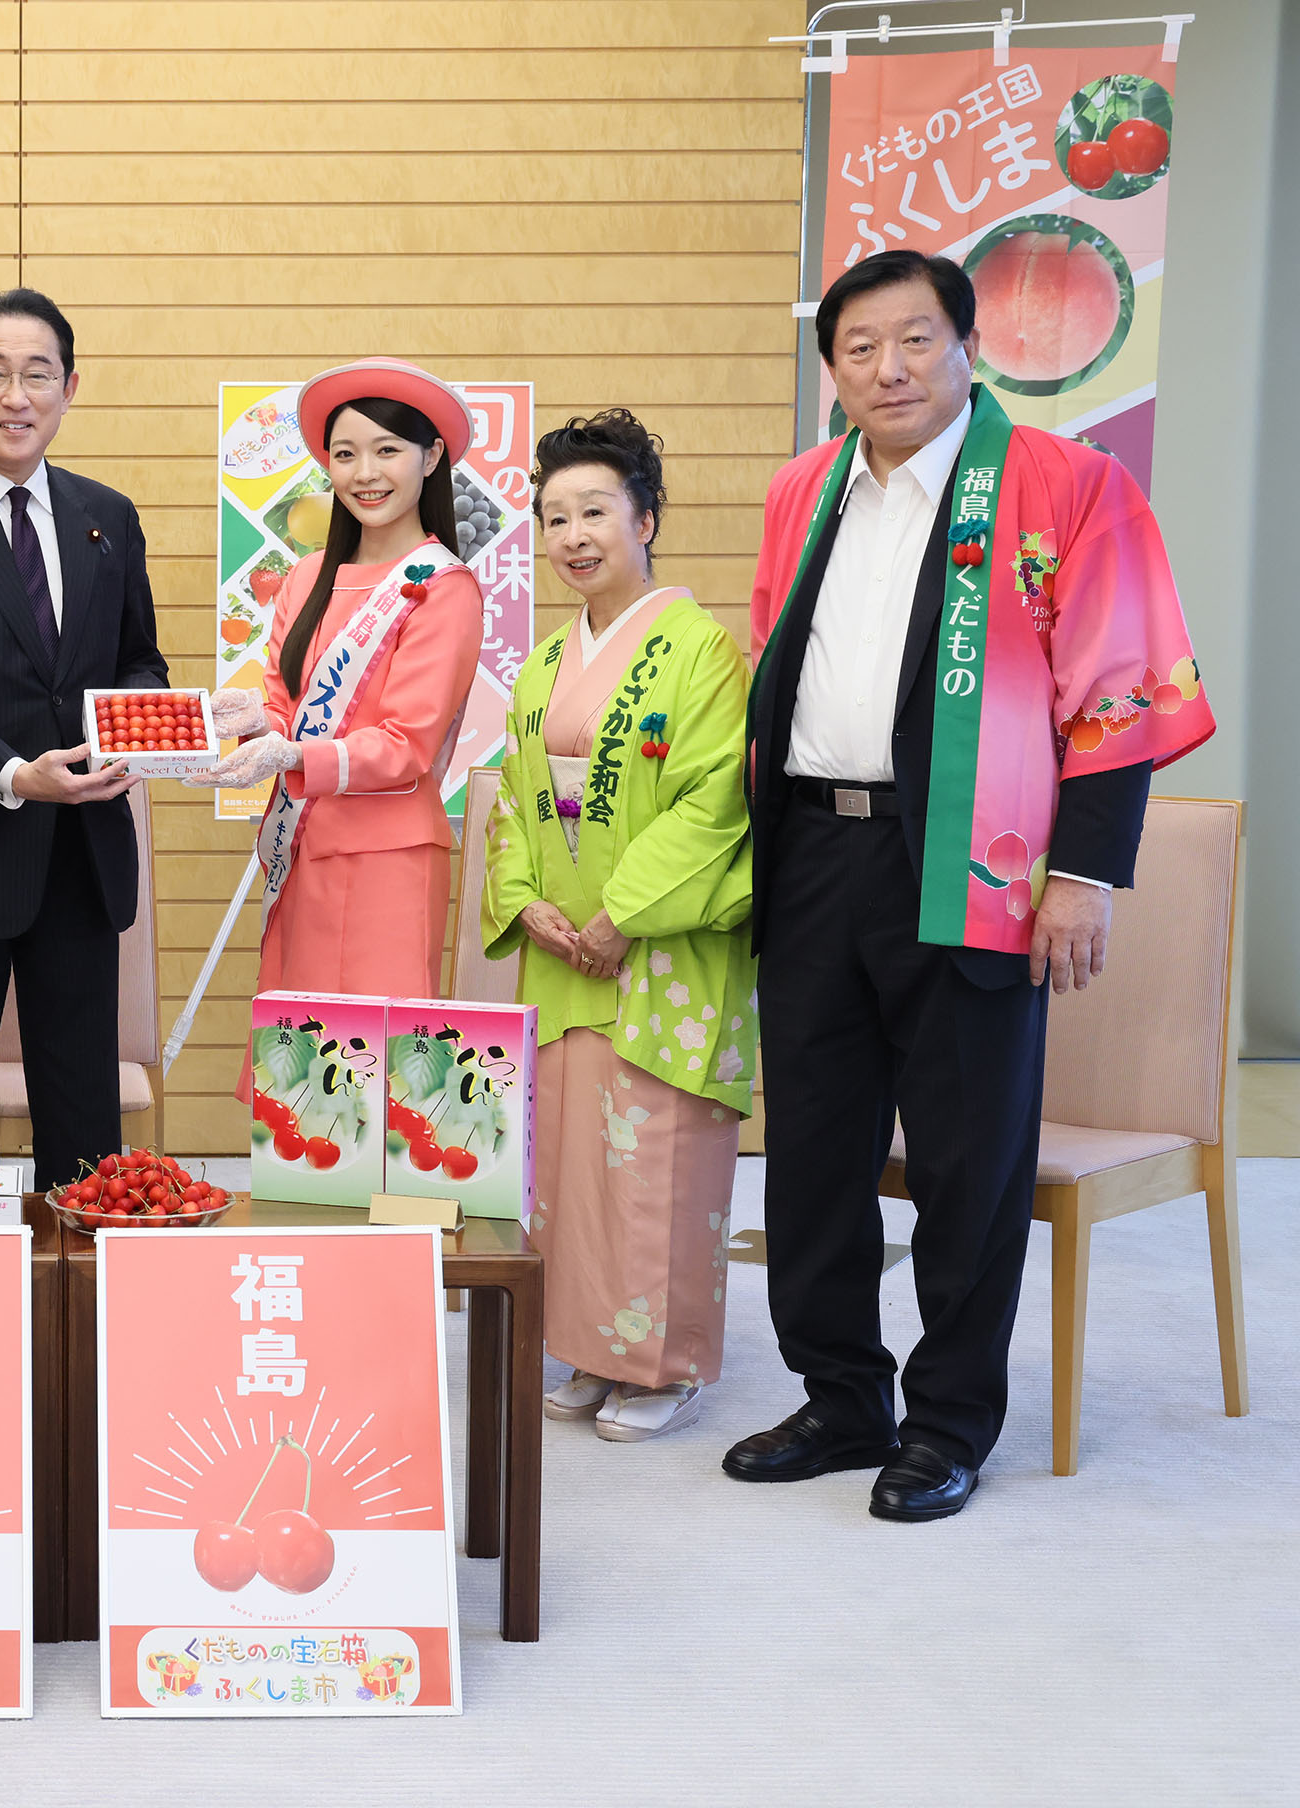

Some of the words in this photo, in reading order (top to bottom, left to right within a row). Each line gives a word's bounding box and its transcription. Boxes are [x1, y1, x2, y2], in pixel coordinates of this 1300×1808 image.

[841, 63, 1042, 187] くだもの王国
[843, 120, 1051, 267] ふくしま
[276, 1016, 293, 1046] 福島
[298, 1014, 378, 1097] さくらんぼ
[412, 1024, 429, 1054] 福島
[435, 1022, 517, 1106] さくらんぼ
[231, 1253, 308, 1397] 福島
[184, 1633, 368, 1667] くだものの宝石箱
[213, 1675, 339, 1705] ふくしま市
